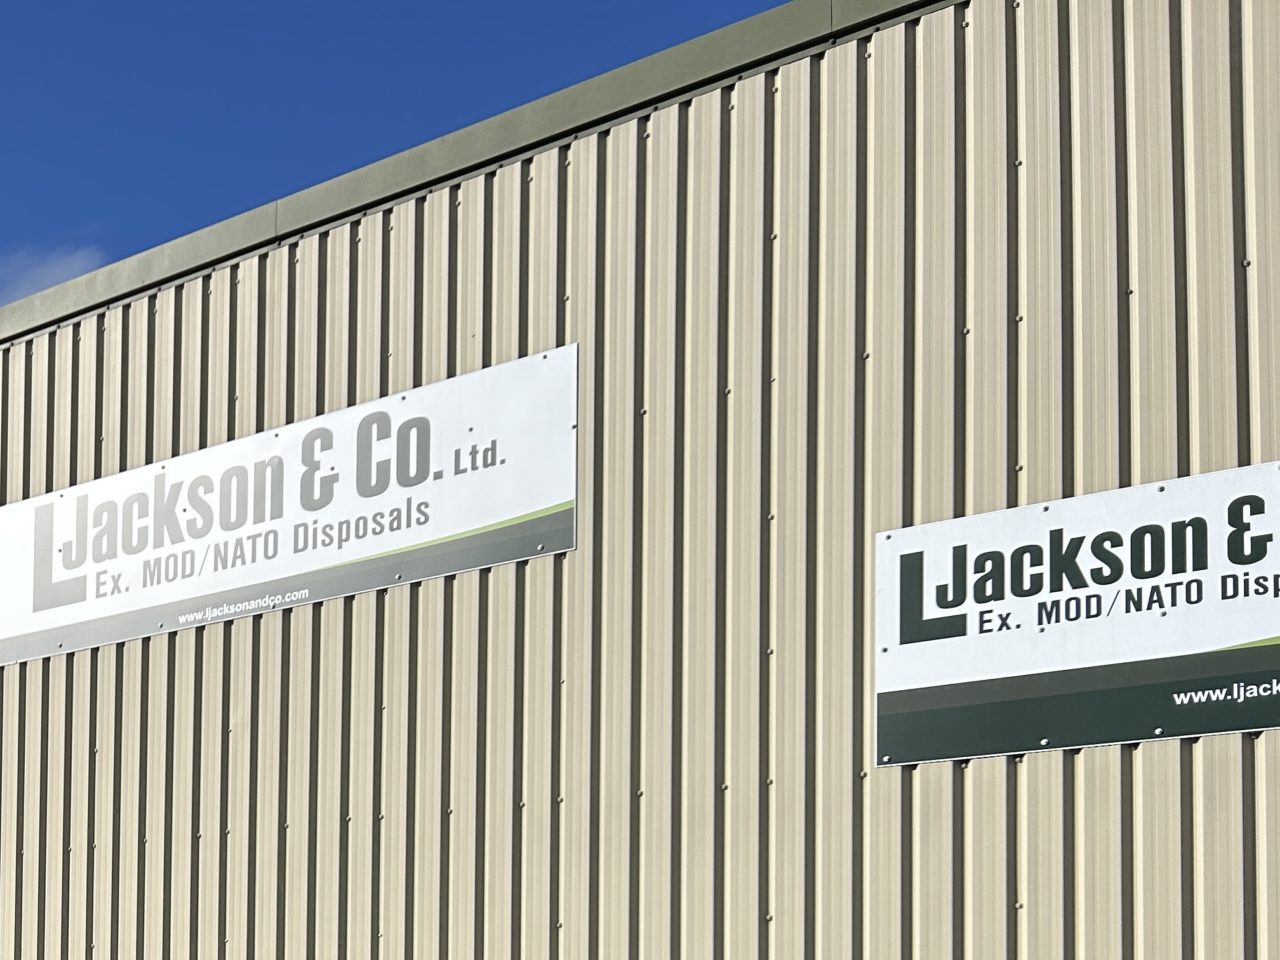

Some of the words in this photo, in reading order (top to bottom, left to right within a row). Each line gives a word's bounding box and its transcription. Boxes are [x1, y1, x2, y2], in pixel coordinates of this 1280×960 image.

[299, 426, 339, 511] &
[355, 410, 443, 499] Co.
[453, 438, 506, 476] Ltd.
[95, 570, 129, 599] Ex.
[142, 529, 279, 590] MOD/NATO
[293, 498, 431, 554] Disposals
[1226, 494, 1274, 565] &
[178, 587, 309, 625] www.ljacksonandco.com
[978, 610, 1022, 635] Ex.
[1037, 579, 1204, 626] MOD/NATO
